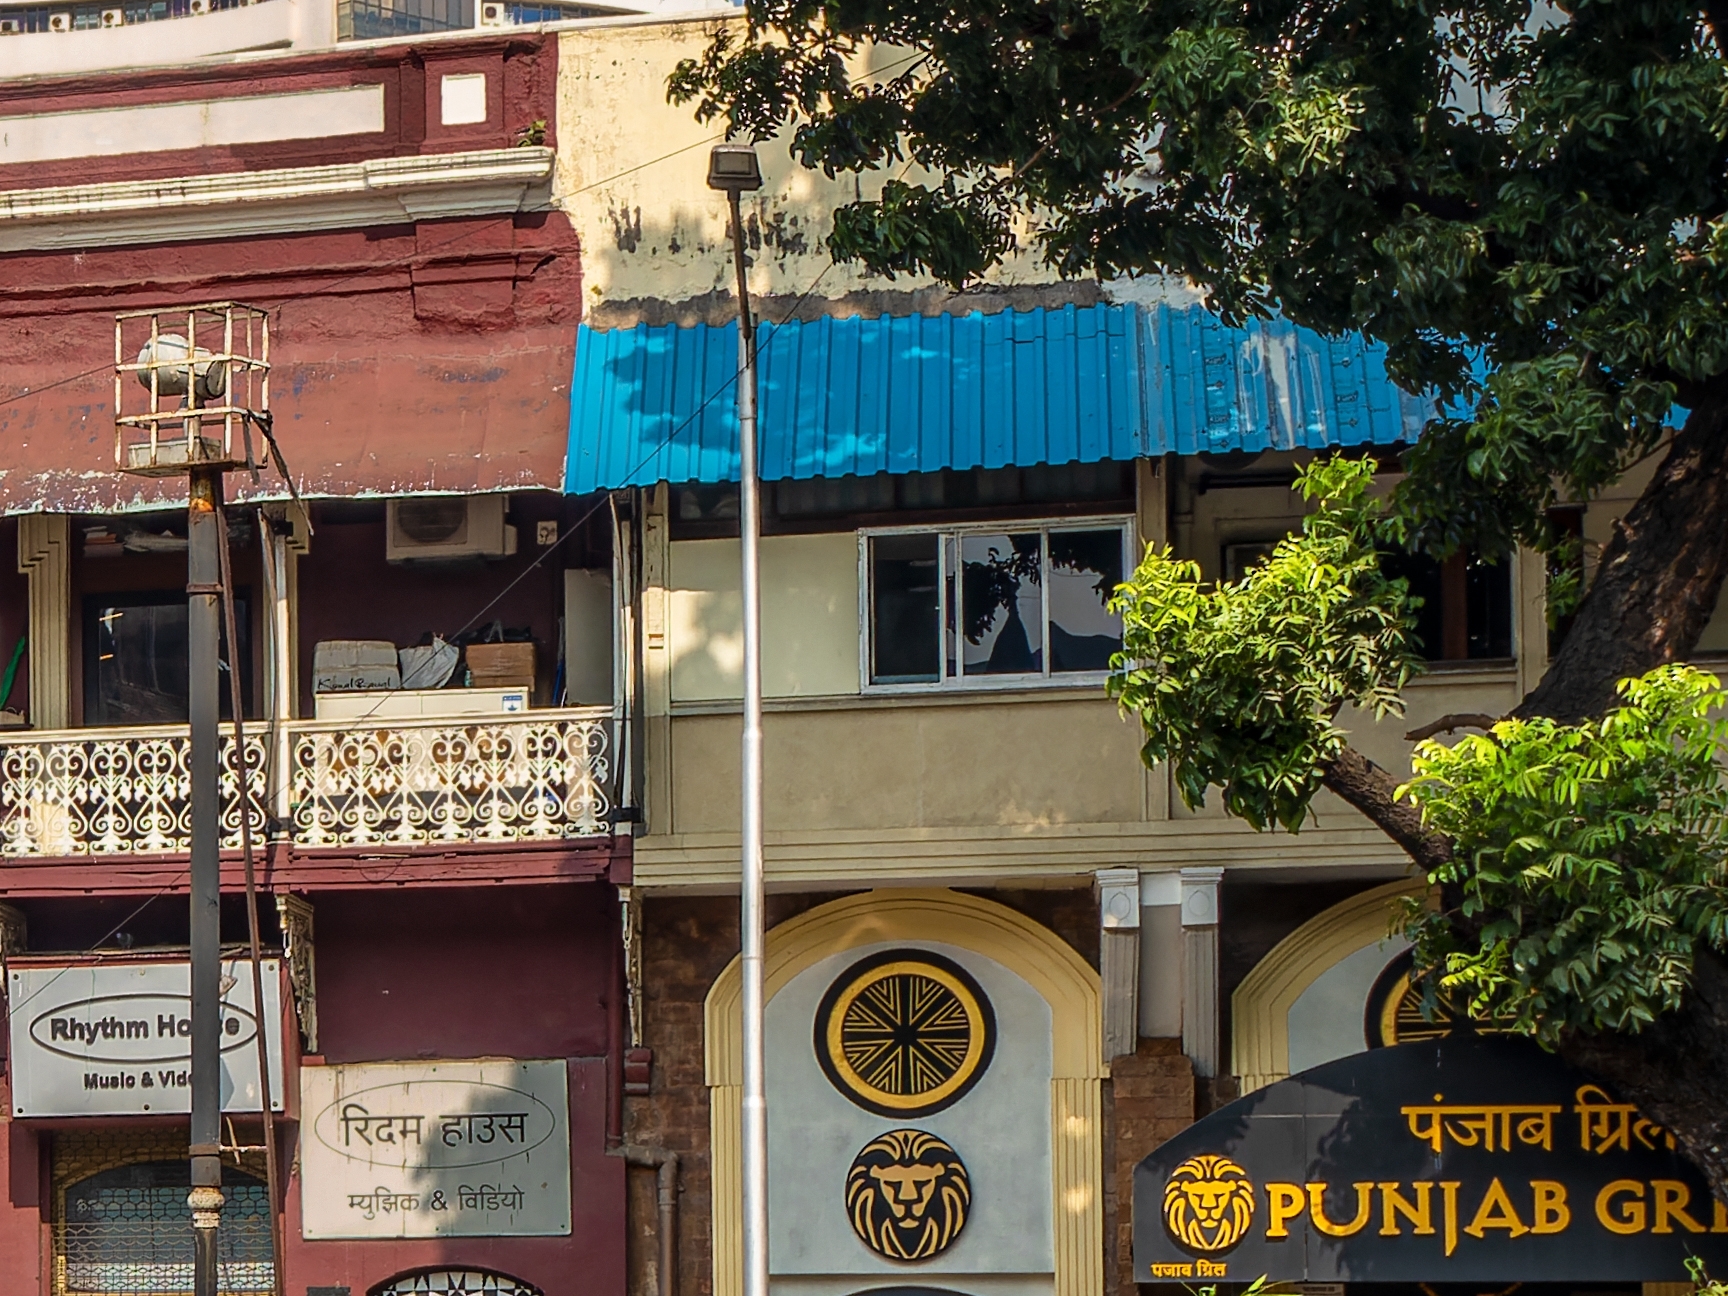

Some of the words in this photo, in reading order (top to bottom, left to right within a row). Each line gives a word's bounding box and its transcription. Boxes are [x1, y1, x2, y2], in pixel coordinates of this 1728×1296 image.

[51, 1016, 149, 1045] Rhythm
[157, 1014, 241, 1038] Hoe
[84, 1071, 135, 1090] Music
[141, 1071, 154, 1089] &
[158, 1070, 192, 1088] Vid
[340, 1103, 425, 1146] रिदम
[439, 1113, 529, 1148] हाउस
[1401, 1094, 1561, 1153] पंजाब
[347, 1186, 420, 1221] म्युझिक
[430, 1190, 448, 1211] &
[1265, 1177, 1571, 1258] PUNJAB
